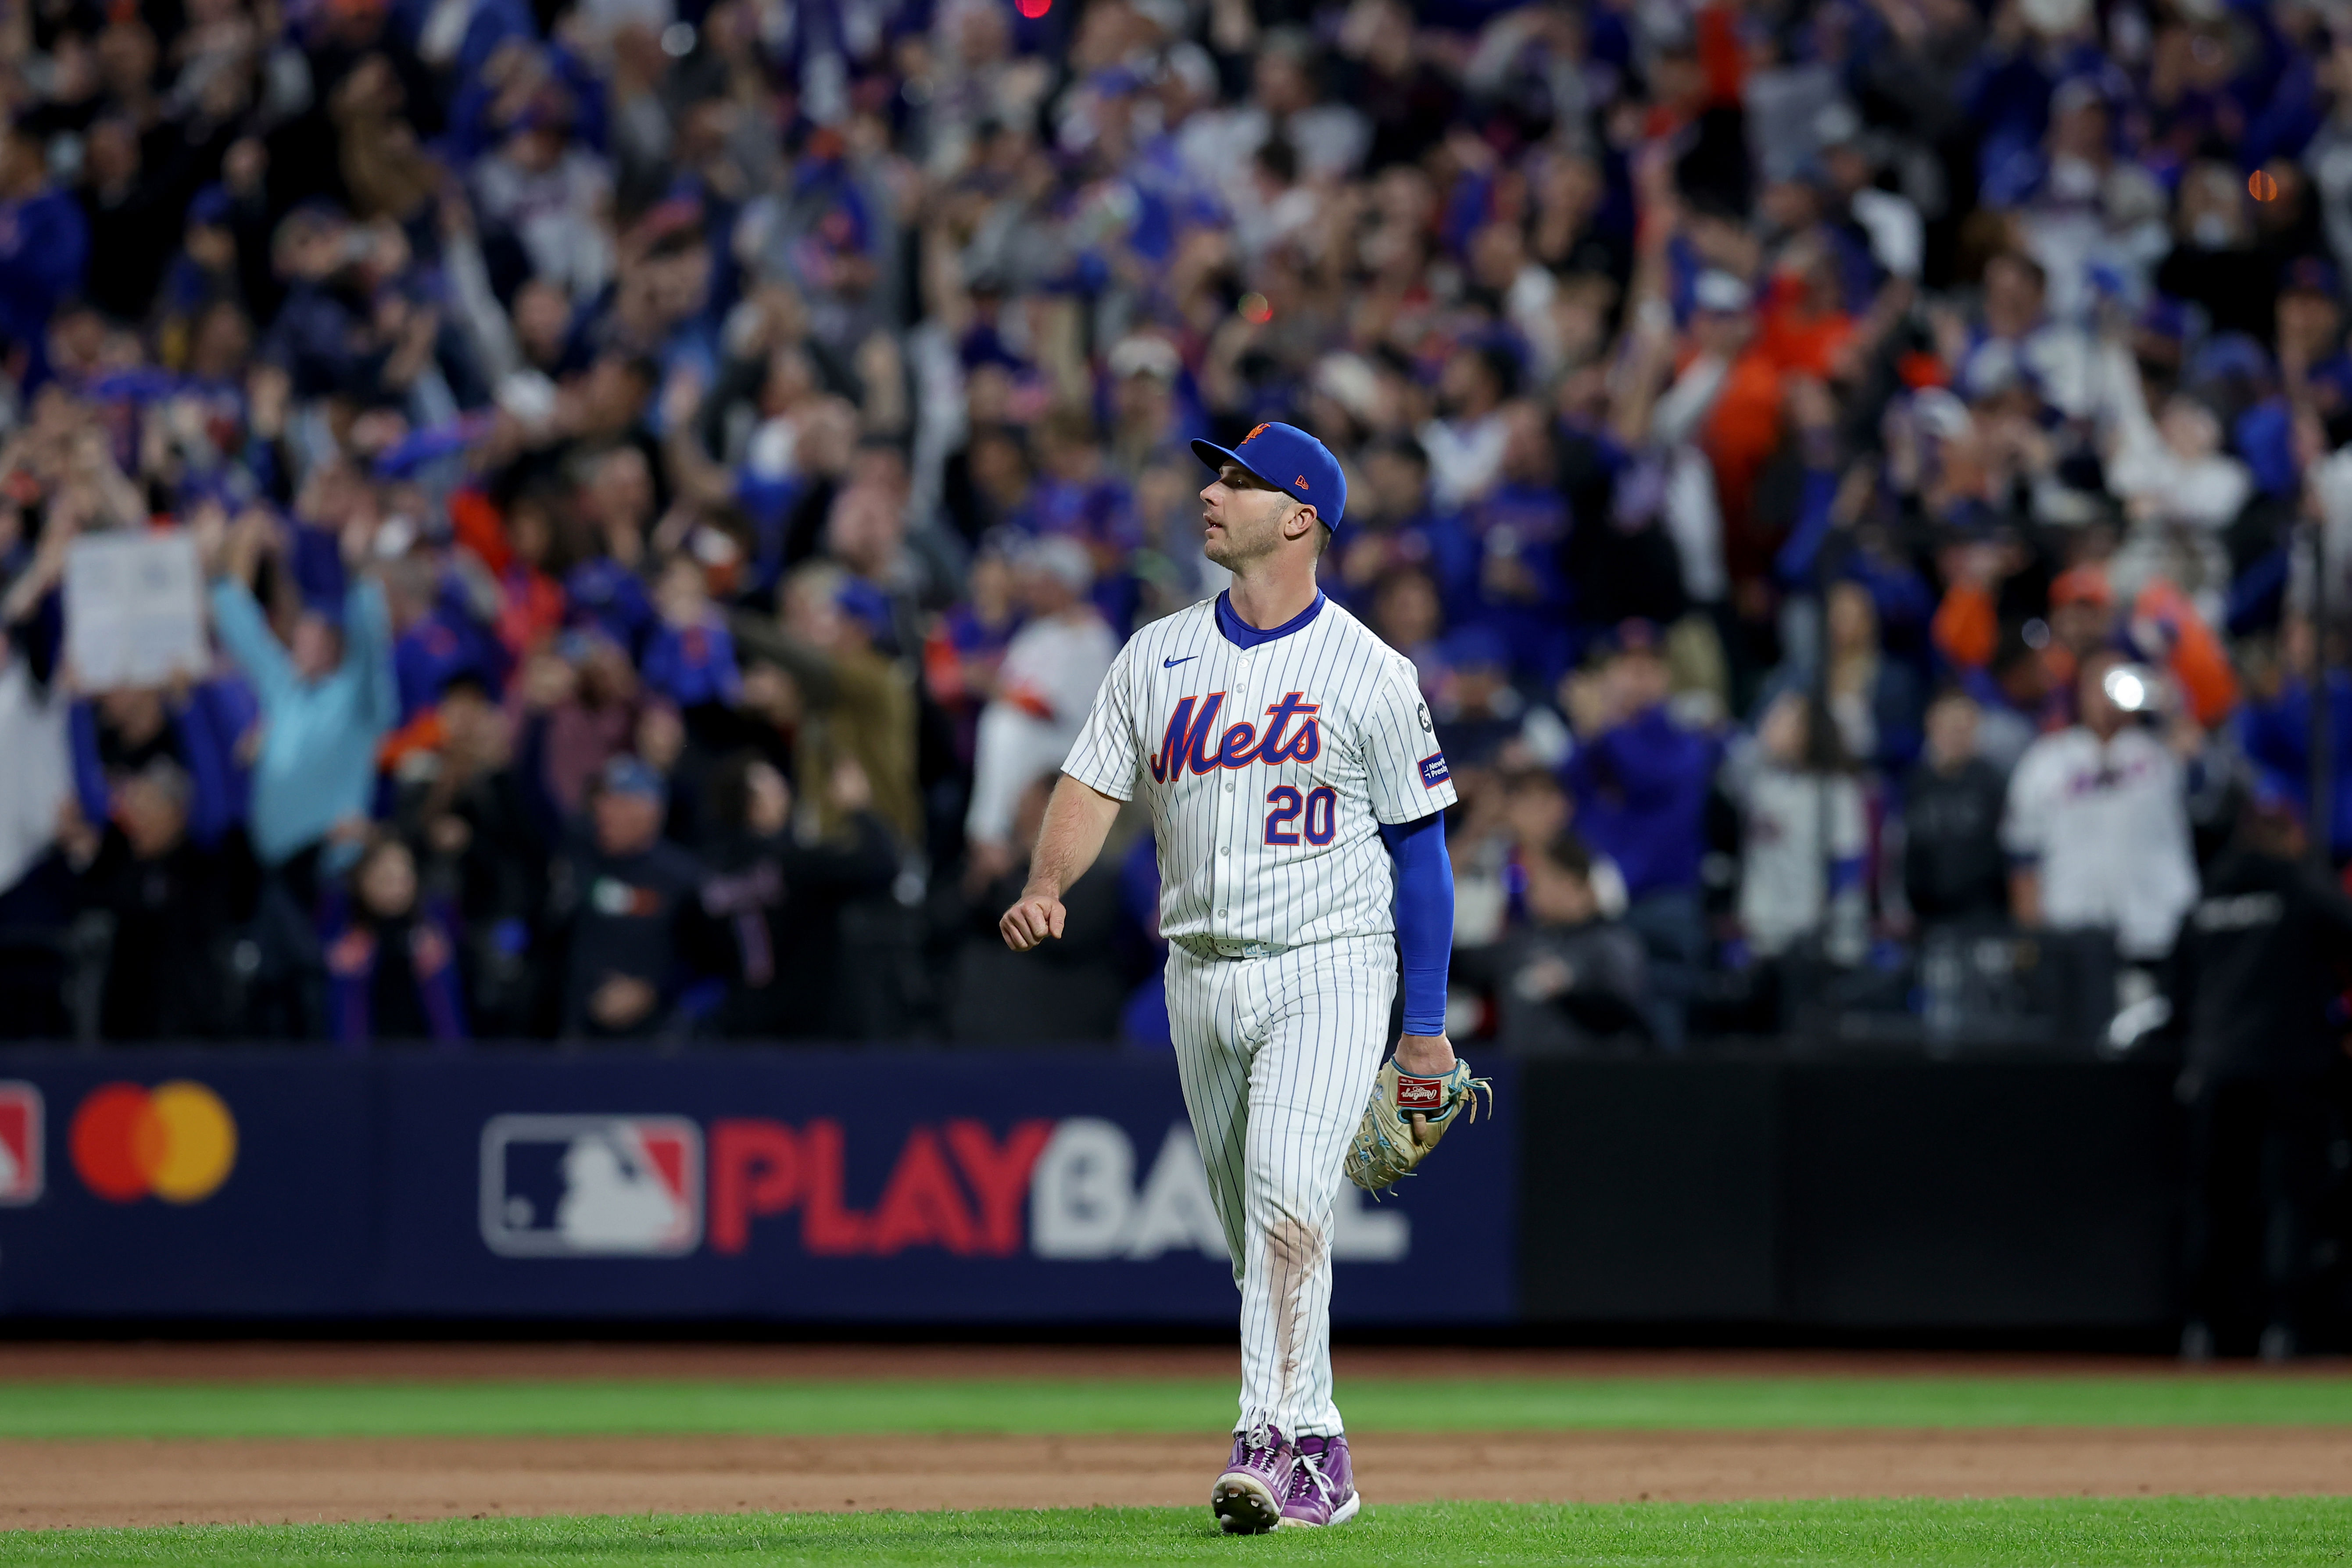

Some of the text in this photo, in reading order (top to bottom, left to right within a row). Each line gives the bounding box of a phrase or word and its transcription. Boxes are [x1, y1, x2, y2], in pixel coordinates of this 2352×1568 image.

[1151, 691, 1320, 784] Mets
[1419, 707, 1431, 728] 24
[1264, 785, 1337, 846] 20
